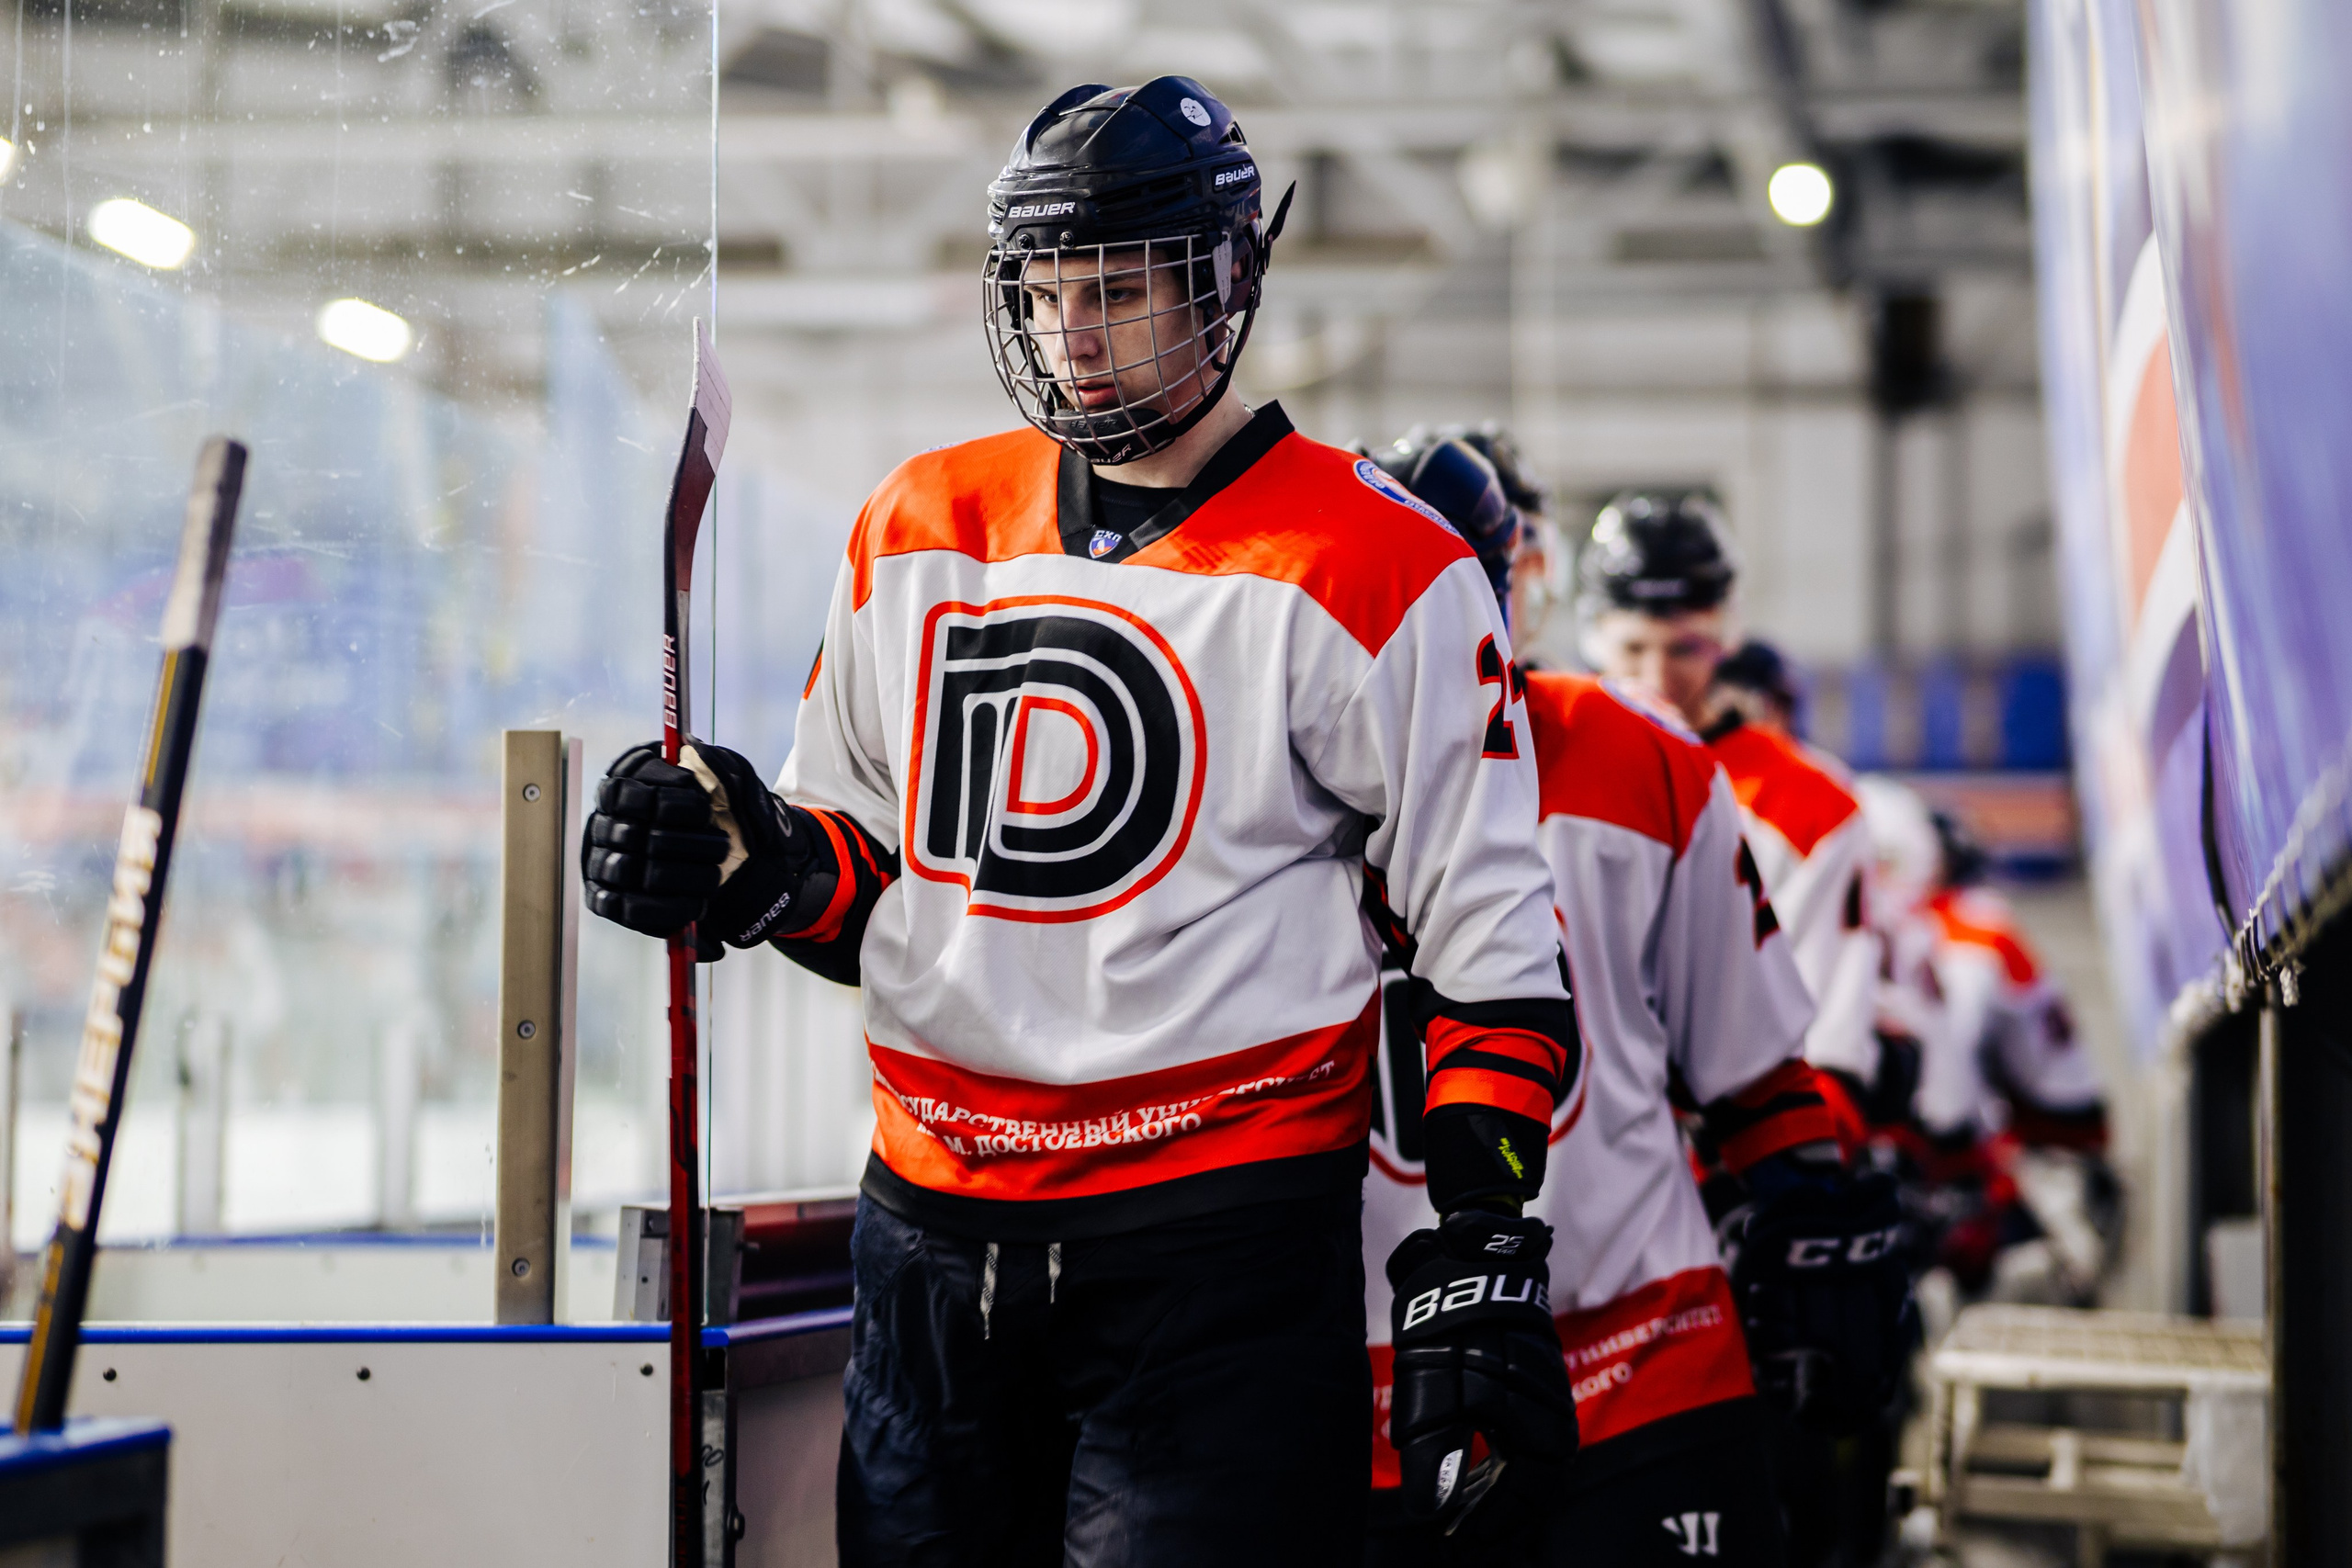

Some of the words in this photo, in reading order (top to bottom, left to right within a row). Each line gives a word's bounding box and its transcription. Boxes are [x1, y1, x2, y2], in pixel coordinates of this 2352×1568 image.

[1215, 164, 1255, 186] BAUER
[1008, 201, 1076, 219] BAUER
[662, 633, 677, 729] BAUER
[739, 892, 791, 942] BAUER
[974, 1112, 1202, 1157] ДОСТОЕВСКОГО
[1787, 1225, 1900, 1268] CC
